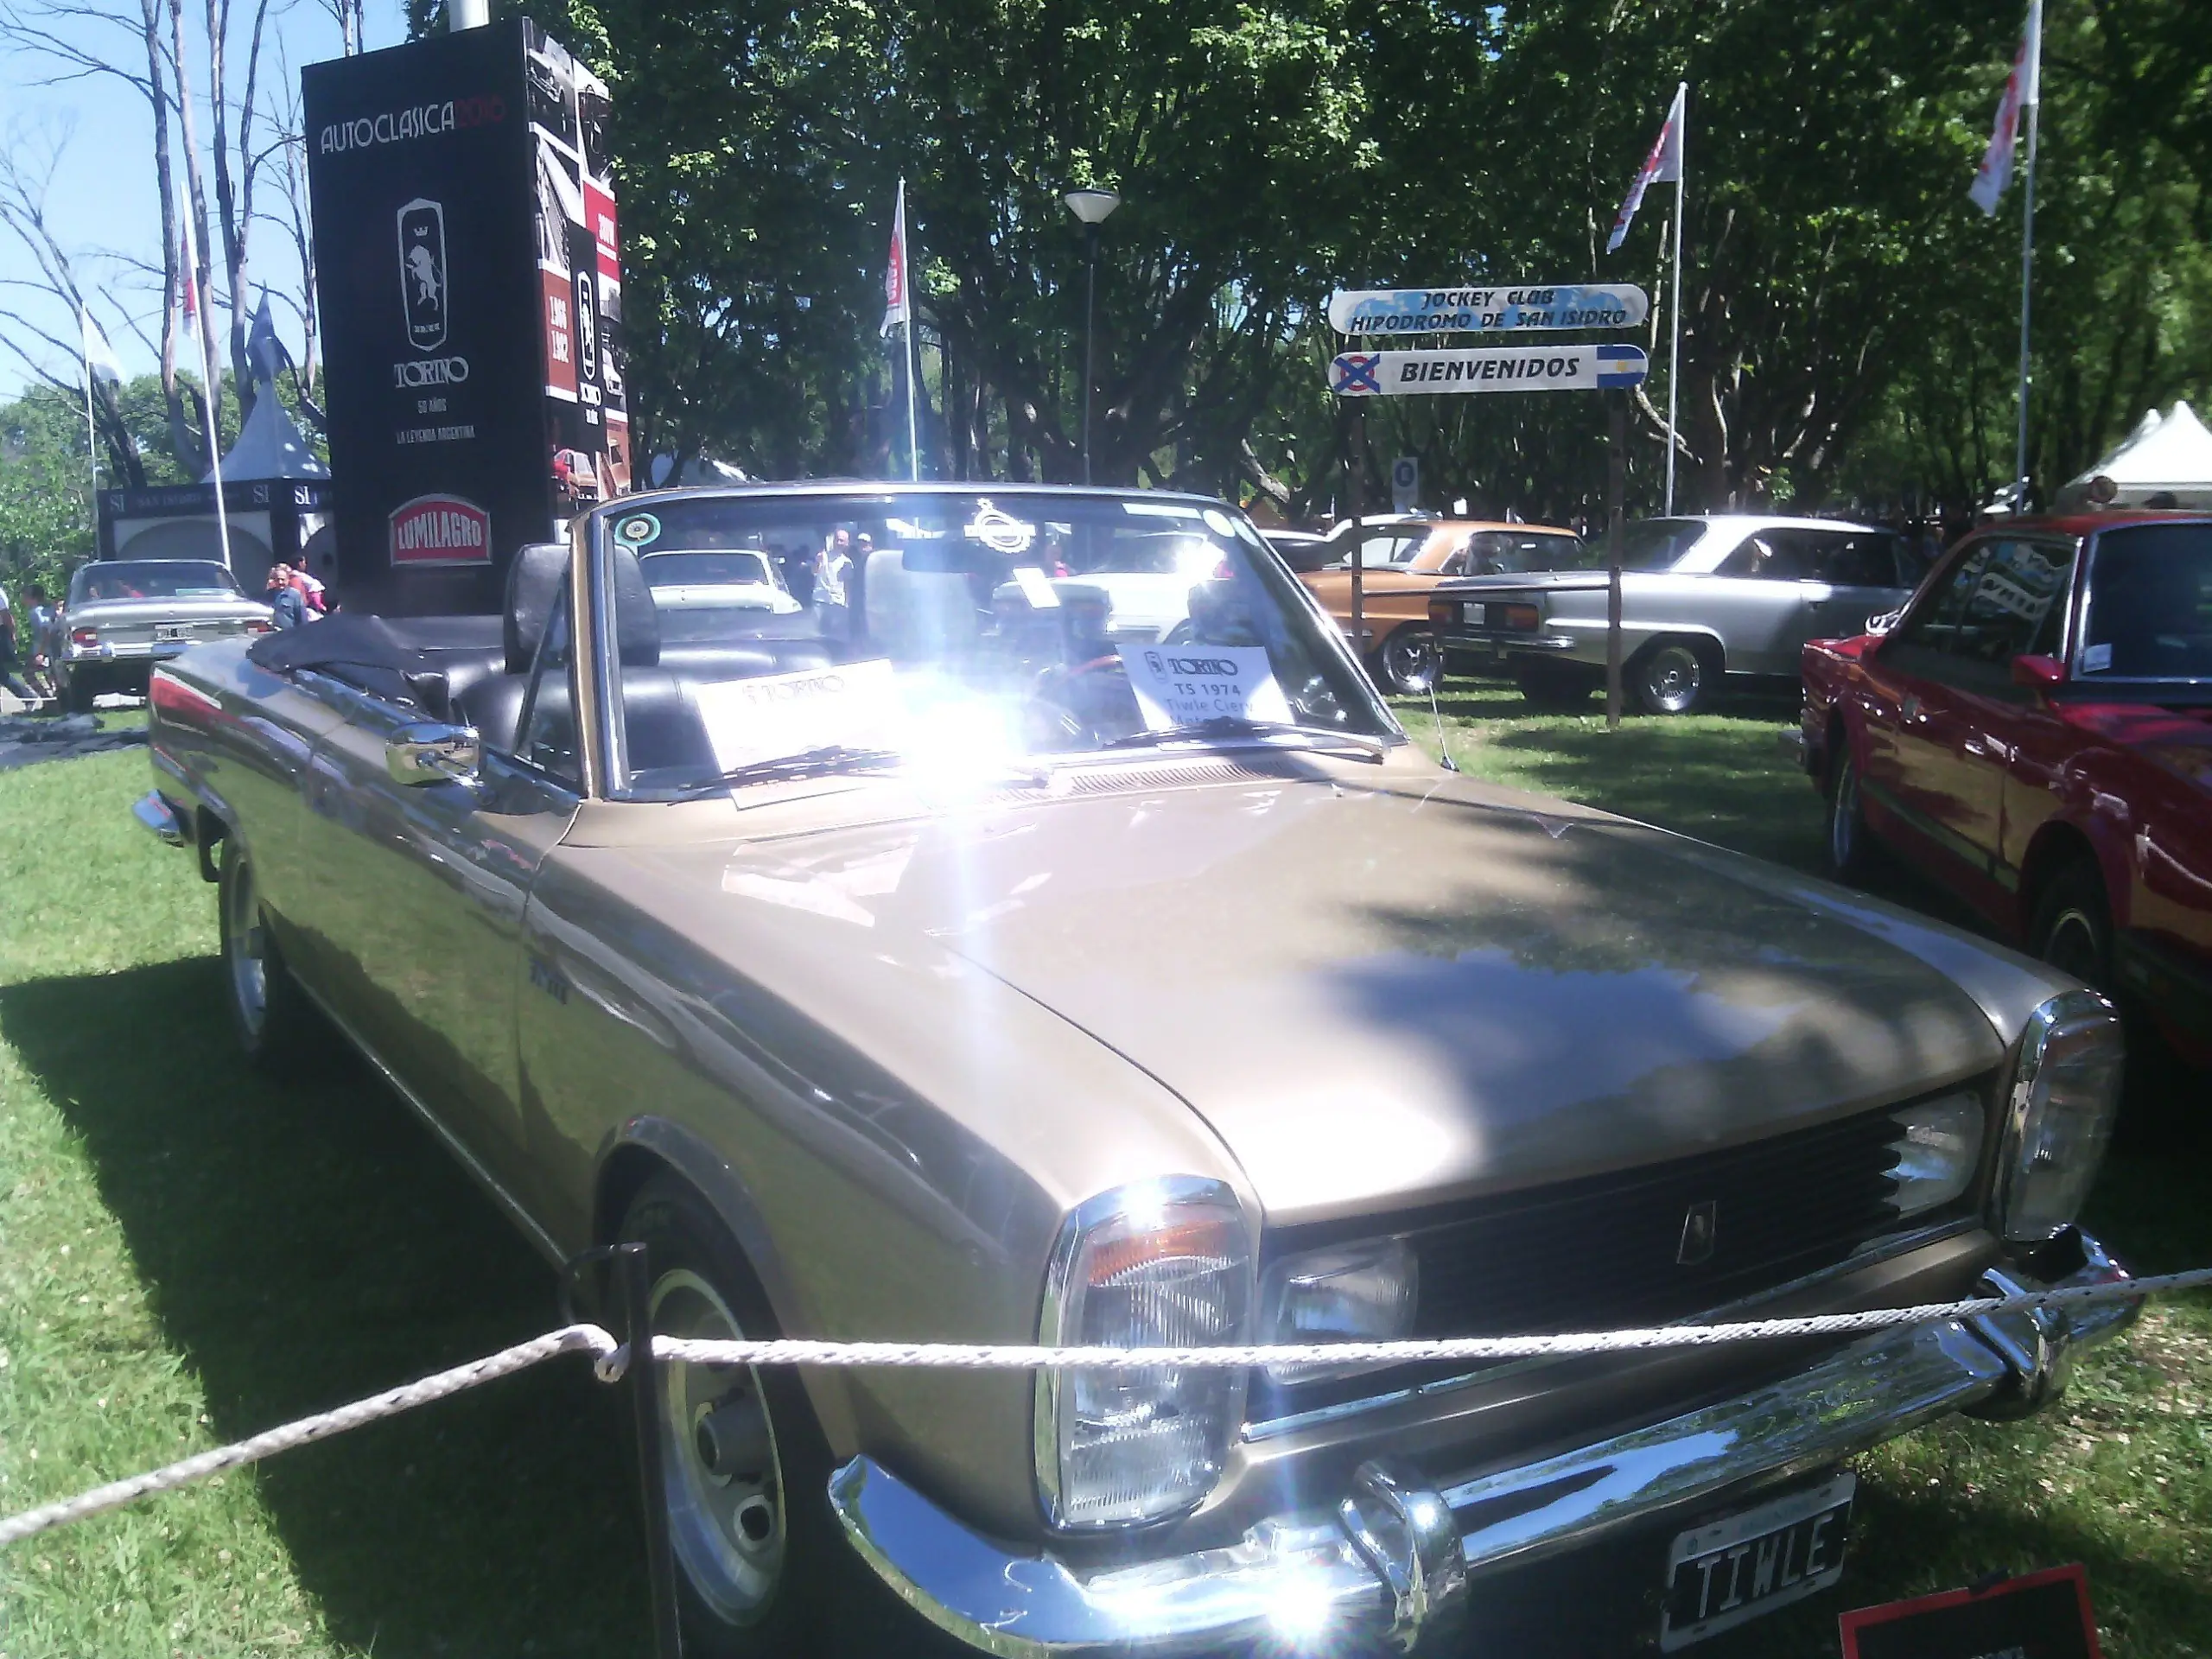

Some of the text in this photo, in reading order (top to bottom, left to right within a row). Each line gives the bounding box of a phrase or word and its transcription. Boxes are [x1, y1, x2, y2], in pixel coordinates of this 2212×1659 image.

[1421, 288, 1555, 310] JOCKEY CLUB
[1350, 309, 1627, 332] HIPODROMO DE SAN ISIDRO
[393, 356, 469, 389] TORINO
[1400, 358, 1580, 382] BIENVENIDOS
[397, 511, 482, 550] LUMILAGRO
[1167, 658, 1239, 677] TORINO
[1174, 683, 1241, 696] TS 1974
[1696, 1511, 1834, 1618] TIWLE
